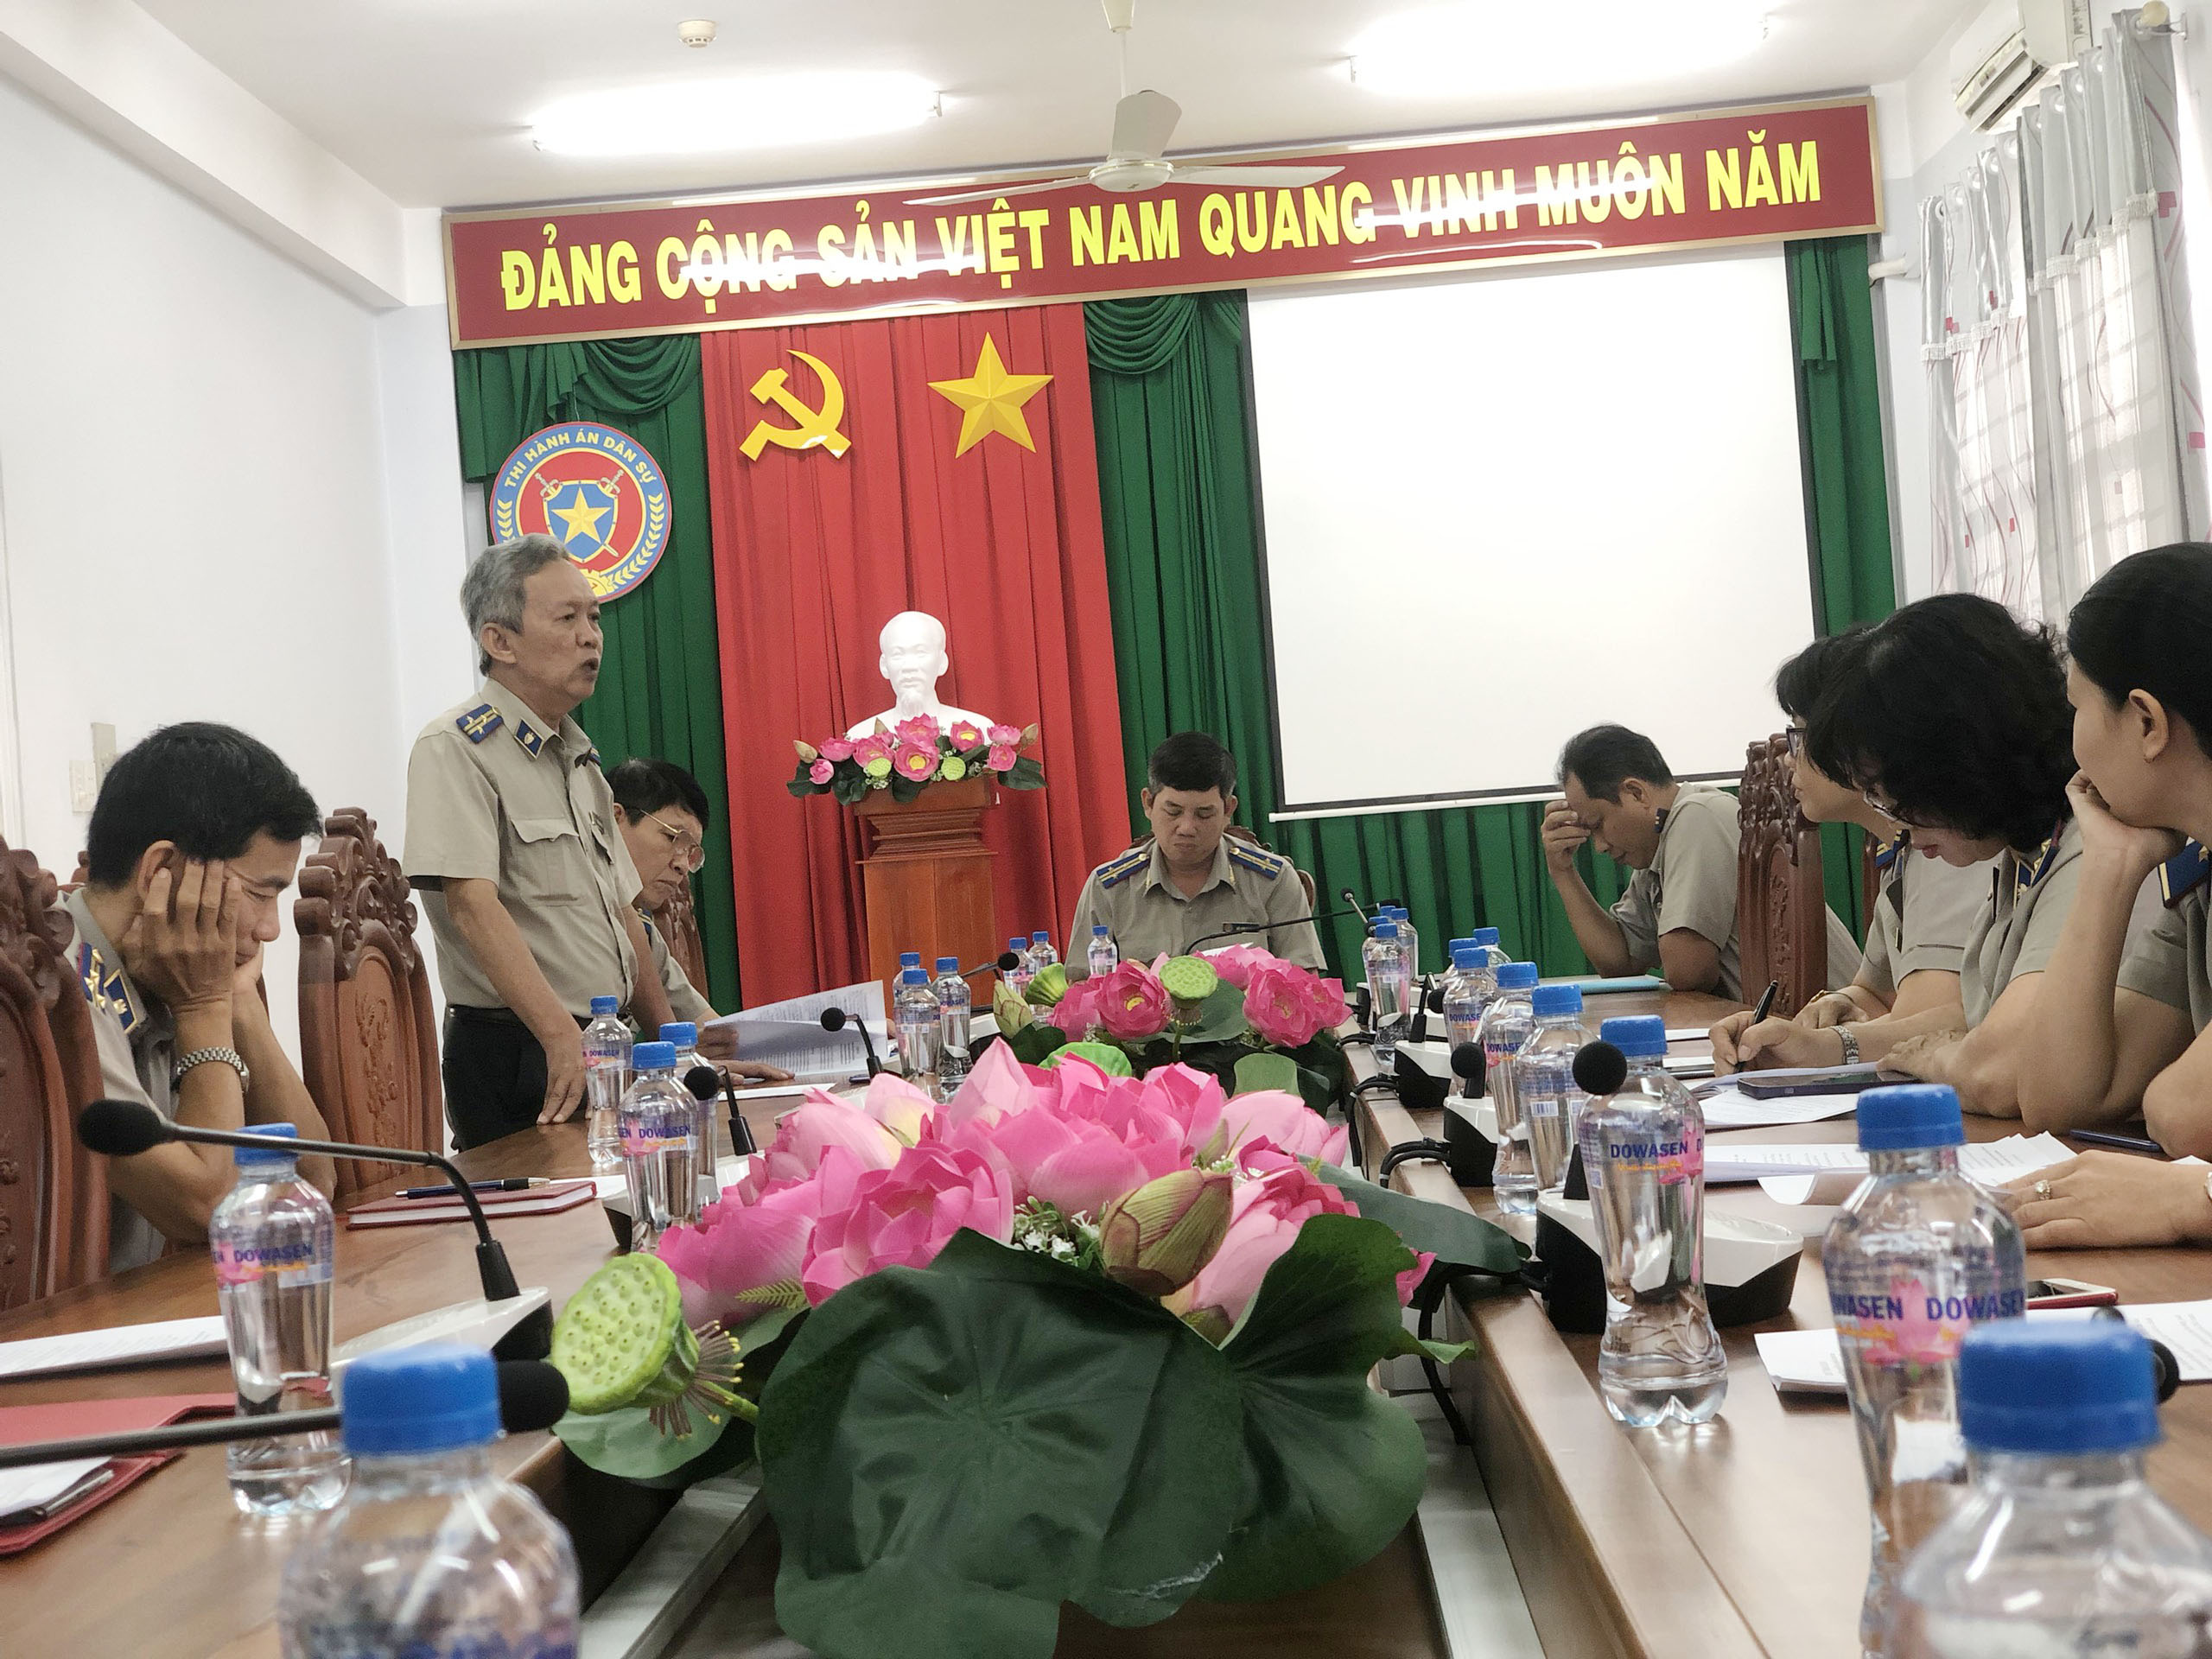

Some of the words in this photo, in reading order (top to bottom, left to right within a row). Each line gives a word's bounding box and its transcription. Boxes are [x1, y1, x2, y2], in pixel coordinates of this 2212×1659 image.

[499, 222, 642, 311] ĐẢNG
[656, 219, 798, 315] CỘNG
[817, 199, 919, 288] SẢN
[935, 198, 1050, 289] VIỆT
[1069, 199, 1180, 267] NAM
[1199, 181, 1377, 259] QUANG
[1391, 168, 1519, 239] VINH
[1534, 141, 1687, 227] MUÔN
[1706, 129, 1821, 212] NĂM
[505, 461, 526, 488] THI
[524, 432, 570, 462] HÀNH
[575, 428, 598, 444] ÁN
[603, 436, 638, 463] DÂN
[635, 461, 658, 484] SỰ
[1449, 1014, 1481, 1022] DOWASE
[1486, 1042, 1521, 1052] DOWASE
[639, 1125, 690, 1138] DOWASEN
[1611, 1141, 1688, 1159] DOWASEN
[234, 1243, 313, 1263] DOWASEN
[1830, 1294, 1904, 1320] WASEN
